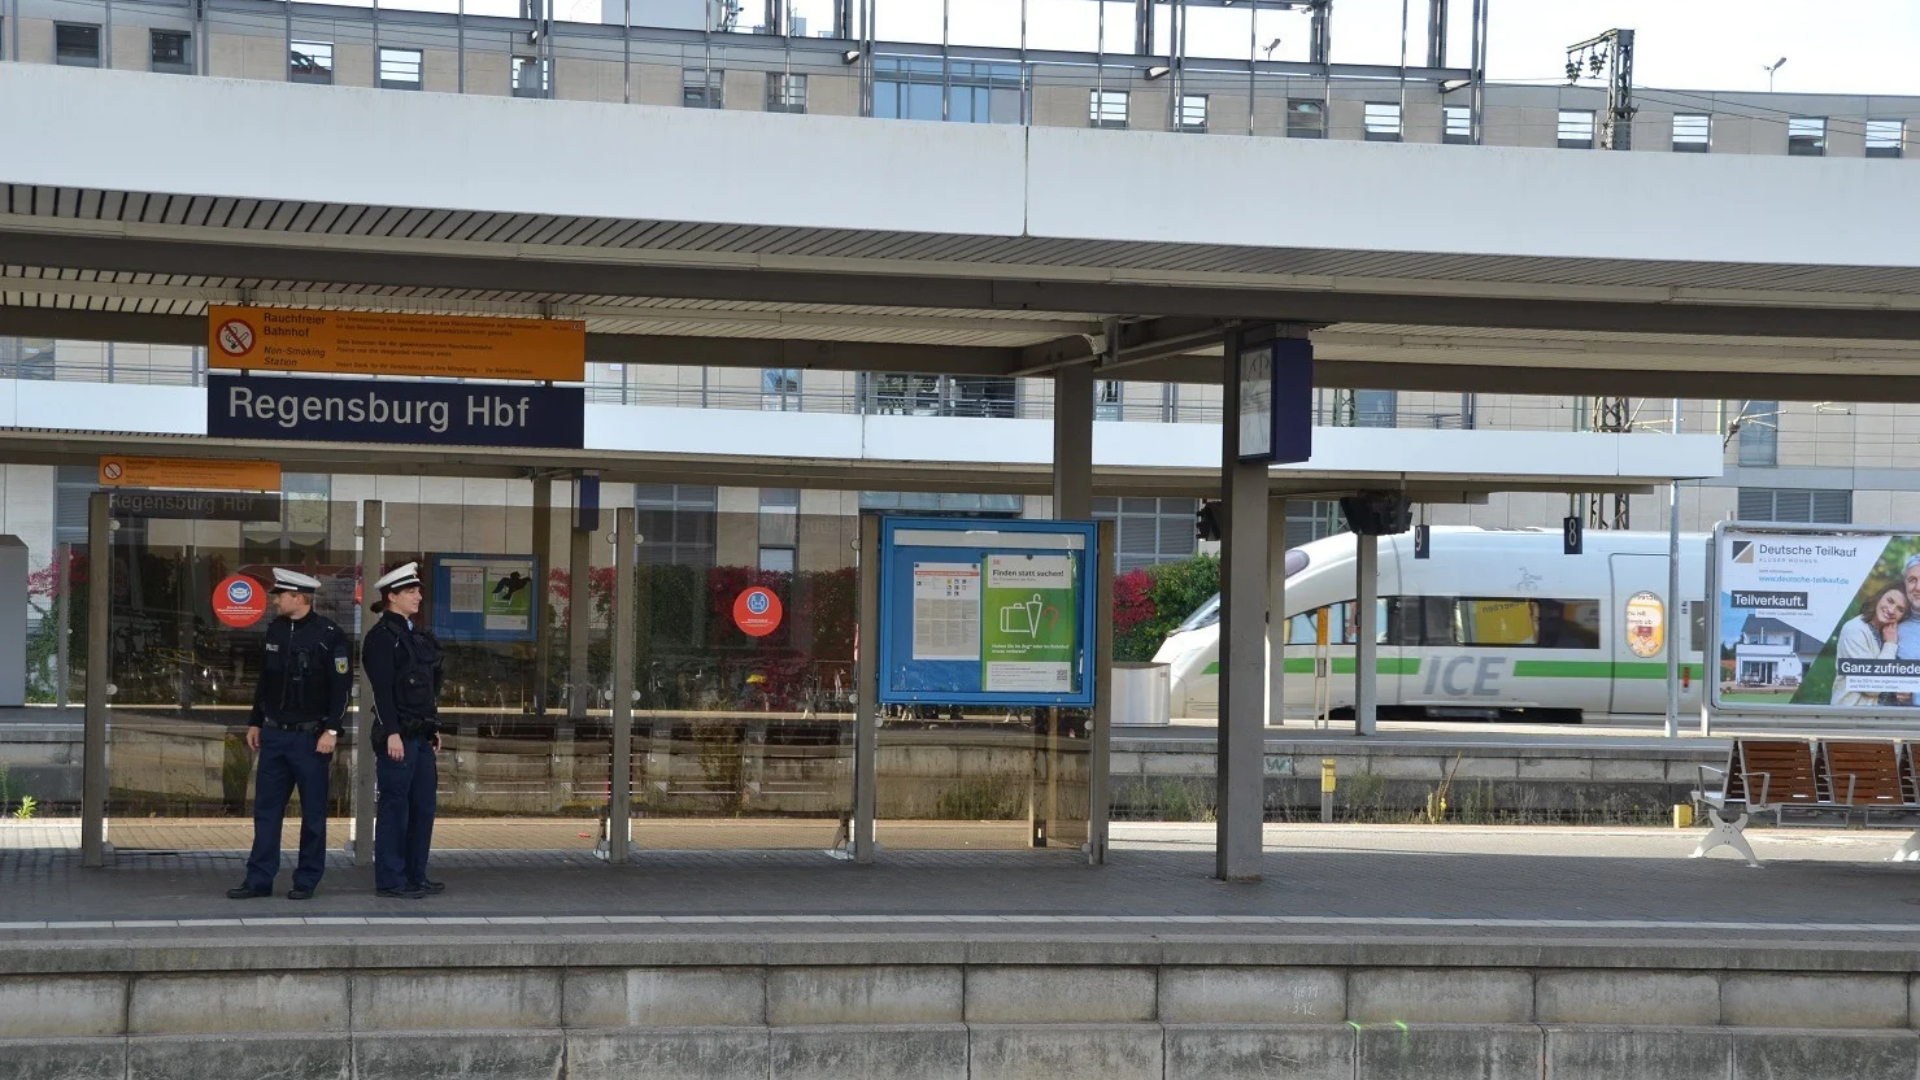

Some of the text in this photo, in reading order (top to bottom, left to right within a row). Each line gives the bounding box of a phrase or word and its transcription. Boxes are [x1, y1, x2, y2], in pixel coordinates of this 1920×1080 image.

[264, 312, 326, 325] Rauchfreier
[264, 326, 309, 337] Bahnhof
[264, 346, 326, 358] Non-Smoking
[264, 356, 297, 366] Station
[229, 386, 530, 433] Regensburg Hbf
[109, 493, 254, 514] Regensburg Hbf
[1569, 518, 1577, 546] 8
[1416, 526, 1422, 552] 9
[1759, 544, 1857, 558] Deutsche Teilkauf
[992, 569, 1017, 577] Finden
[1036, 570, 1064, 578] suchen!
[1734, 594, 1805, 607] Teilverkauft.
[1841, 661, 1872, 673] Ganz
[1422, 655, 1507, 696] ICE
